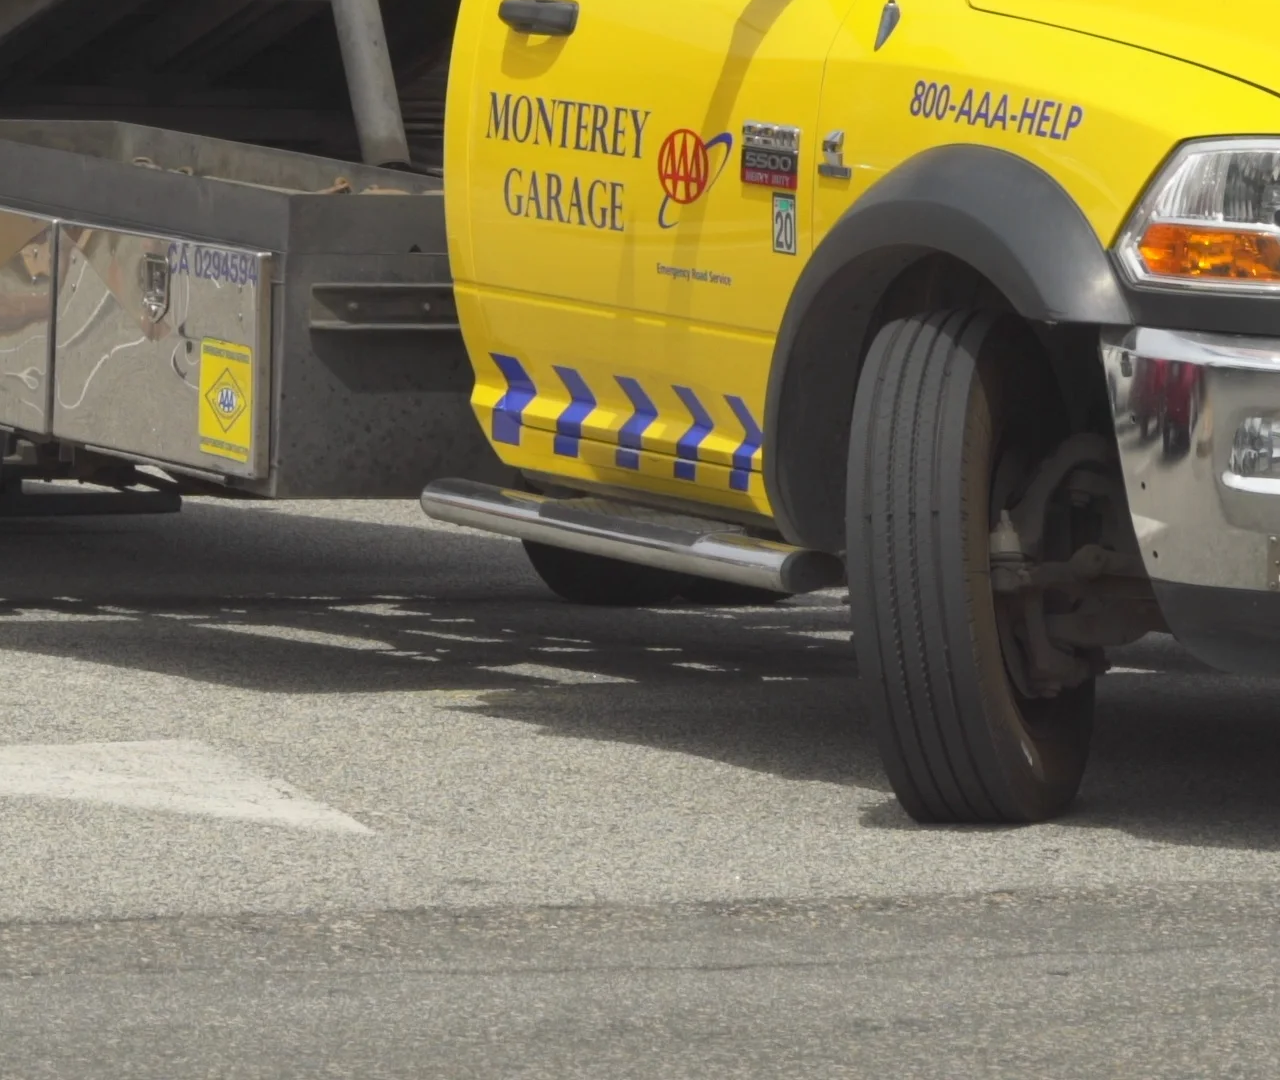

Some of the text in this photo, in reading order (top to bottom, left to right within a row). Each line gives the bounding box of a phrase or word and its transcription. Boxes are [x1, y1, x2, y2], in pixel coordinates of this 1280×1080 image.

[486, 92, 651, 159] MONTEREY
[910, 80, 1083, 141] 800-AAA-HELP
[658, 129, 709, 204] AAA
[745, 151, 792, 172] 5500
[745, 168, 790, 186] HEAVY DUTY
[503, 168, 624, 232] GARAGE
[775, 211, 792, 250] 20
[168, 242, 257, 286] CA 0294594
[656, 262, 731, 286] Emergency Road Service
